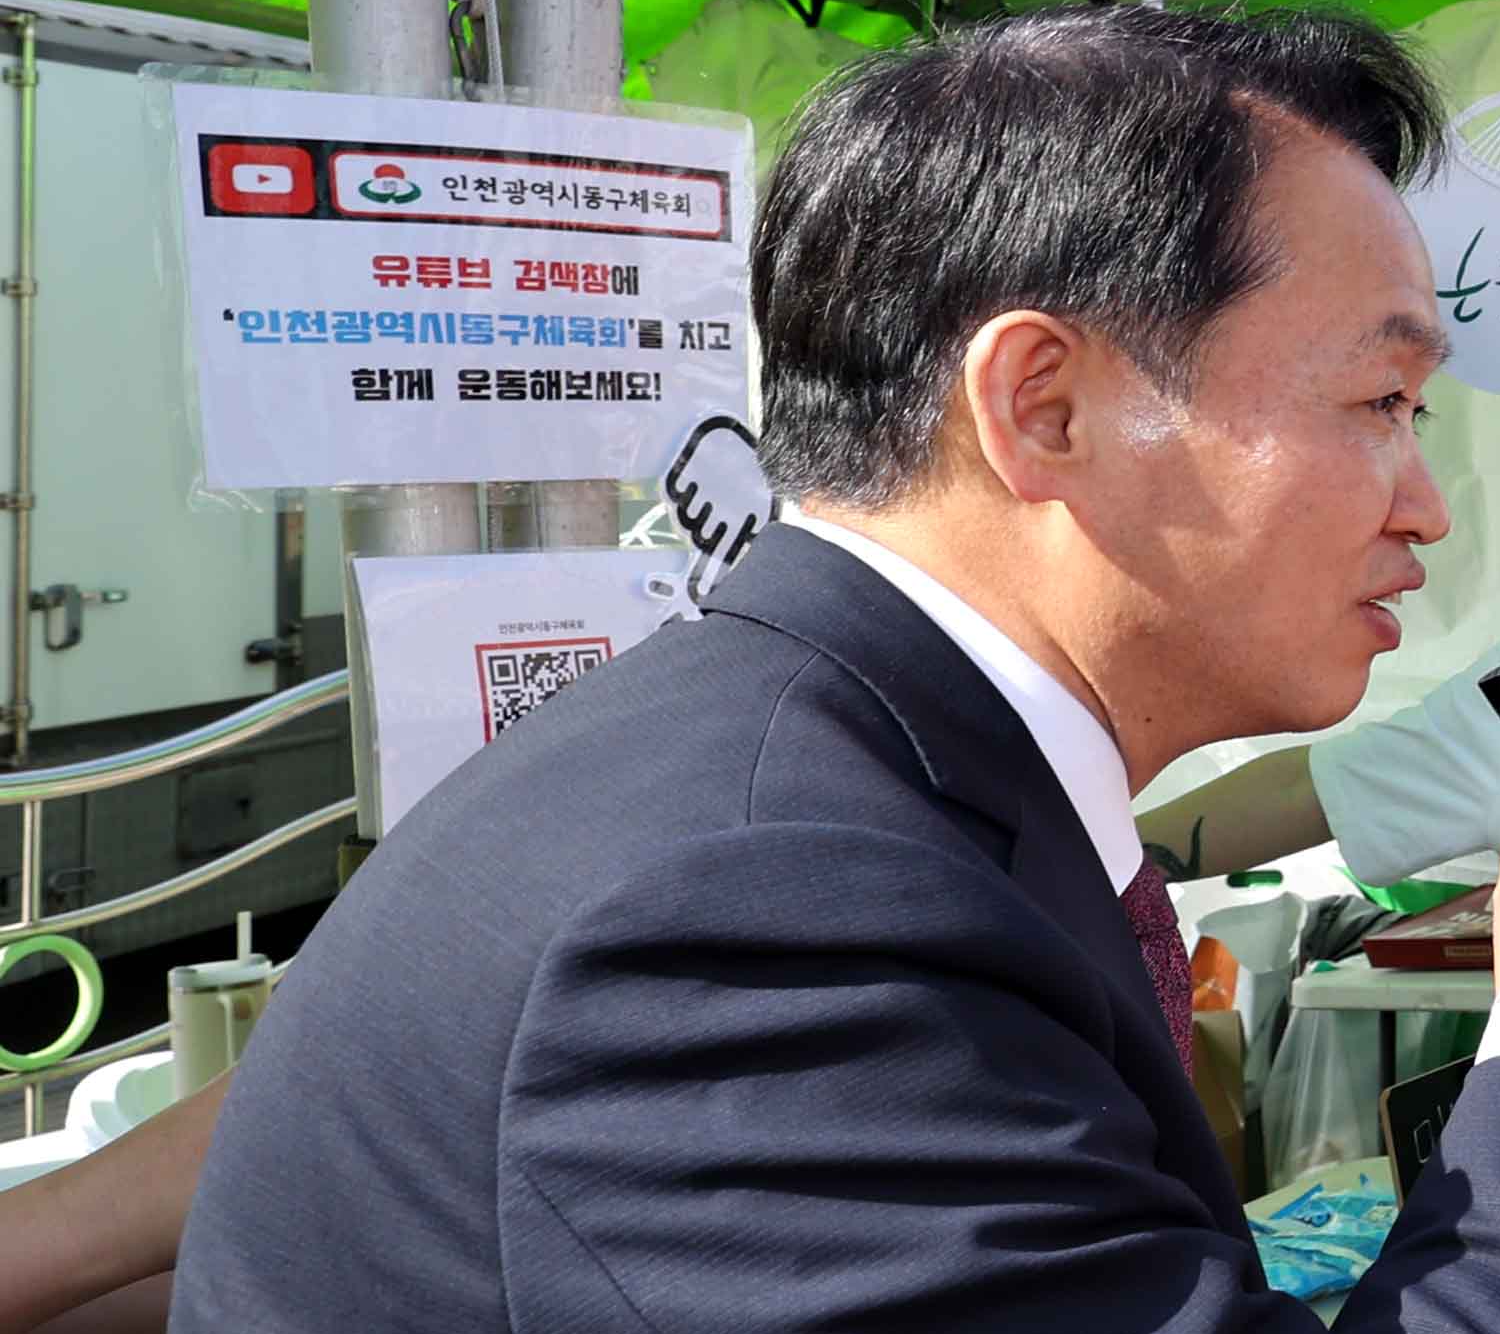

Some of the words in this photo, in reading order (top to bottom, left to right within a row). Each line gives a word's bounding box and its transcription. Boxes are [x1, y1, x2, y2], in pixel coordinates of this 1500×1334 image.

[440, 173, 694, 221] 인천광역시동구체육회
[369, 254, 492, 293] 유튜브
[513, 257, 640, 297] 검색창에
[678, 319, 733, 354] 치고
[349, 367, 435, 404] 함께
[456, 368, 664, 405] 운동해보세요!
